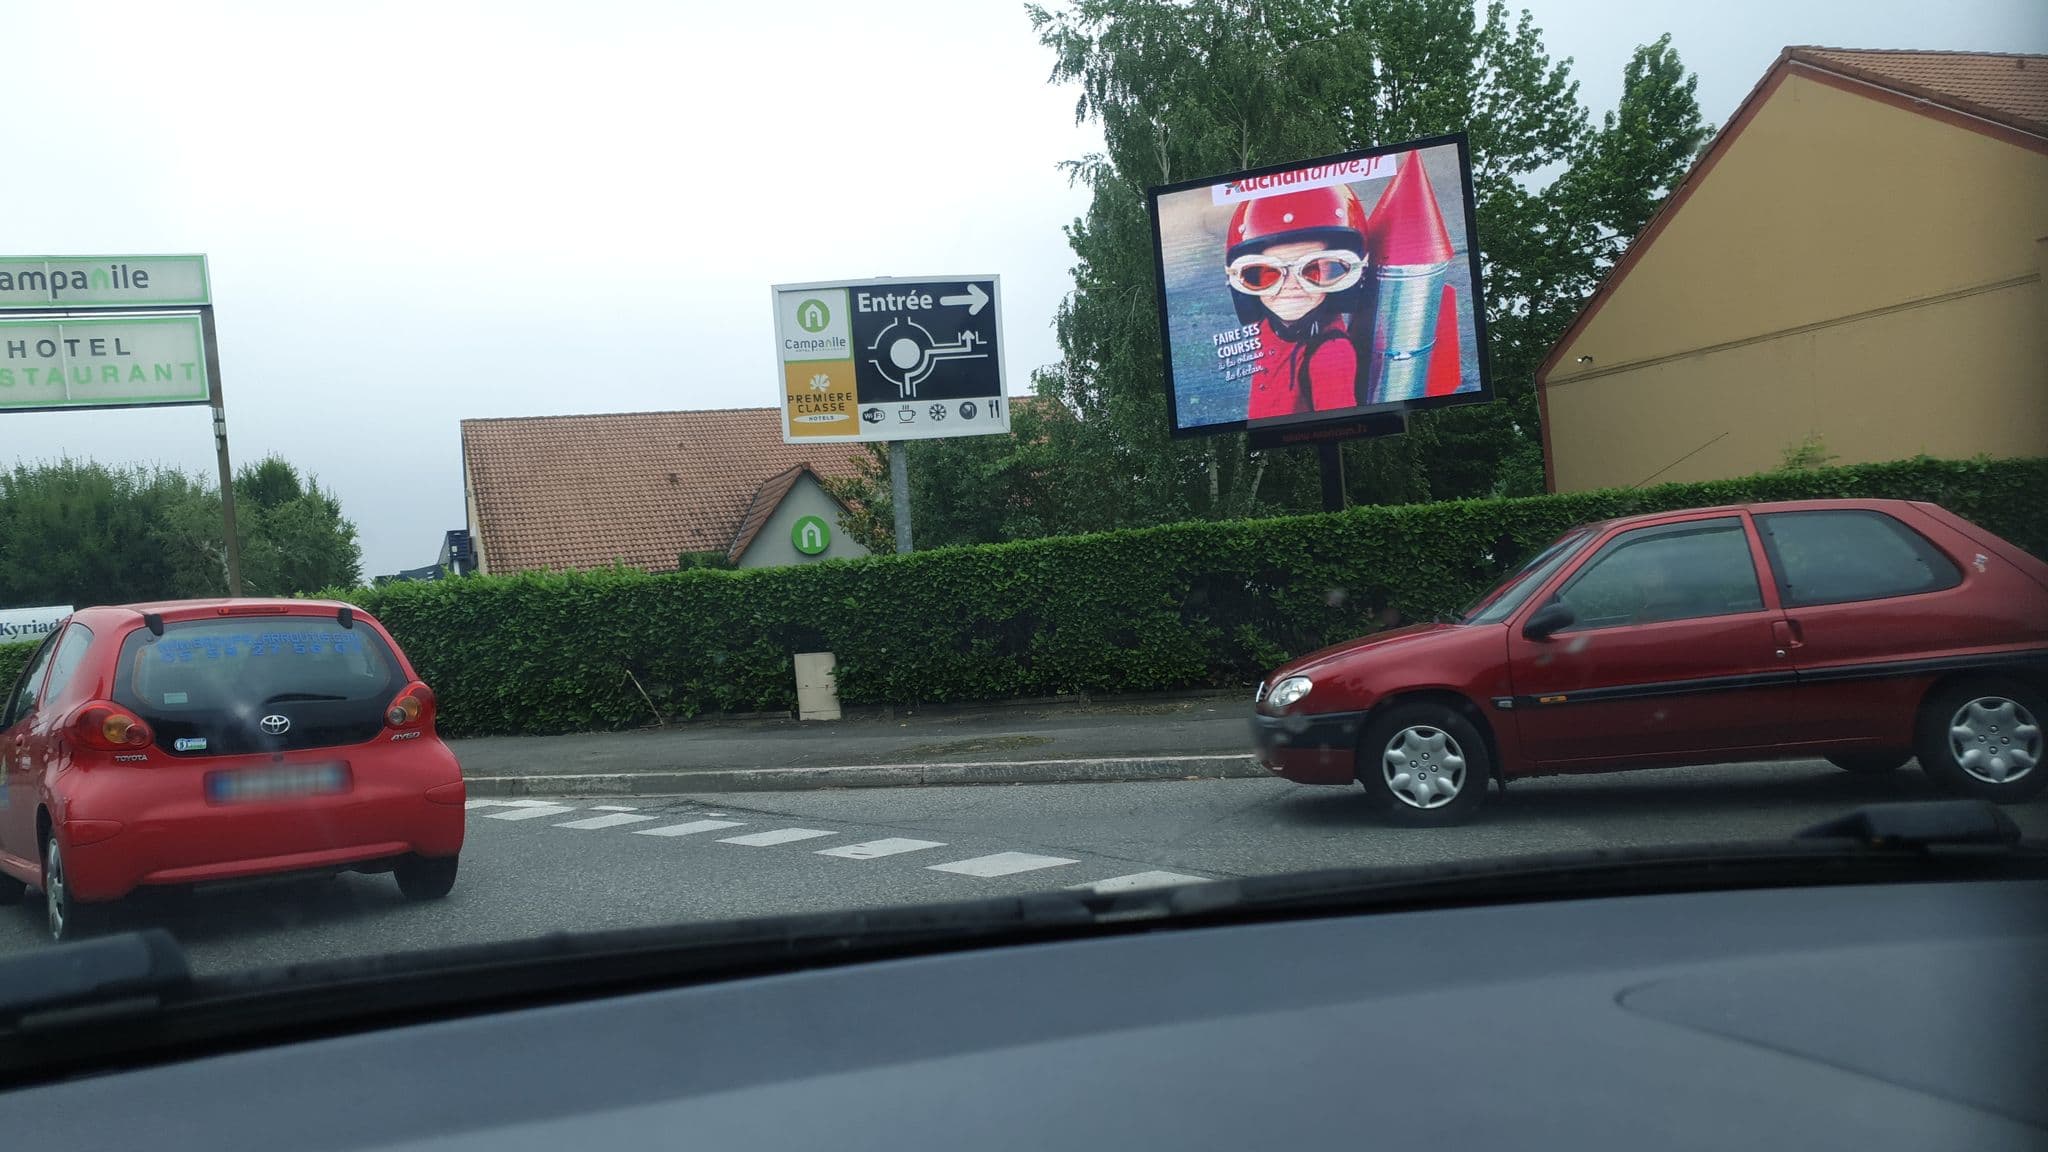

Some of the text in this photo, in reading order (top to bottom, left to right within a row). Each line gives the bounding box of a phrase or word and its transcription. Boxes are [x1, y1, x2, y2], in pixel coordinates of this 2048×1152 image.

[0, 264, 149, 299] ampanile
[857, 290, 933, 312] Entrée
[785, 337, 846, 352] Campanile
[1213, 323, 1261, 346] FAIRE SES
[7, 337, 131, 359] HOTEL
[1217, 337, 1262, 359] COURSES
[0, 362, 196, 387] STAURANT
[787, 392, 853, 404] PREMIERE
[798, 402, 846, 413] CLASSE
[115, 754, 148, 762] TOYOTA
